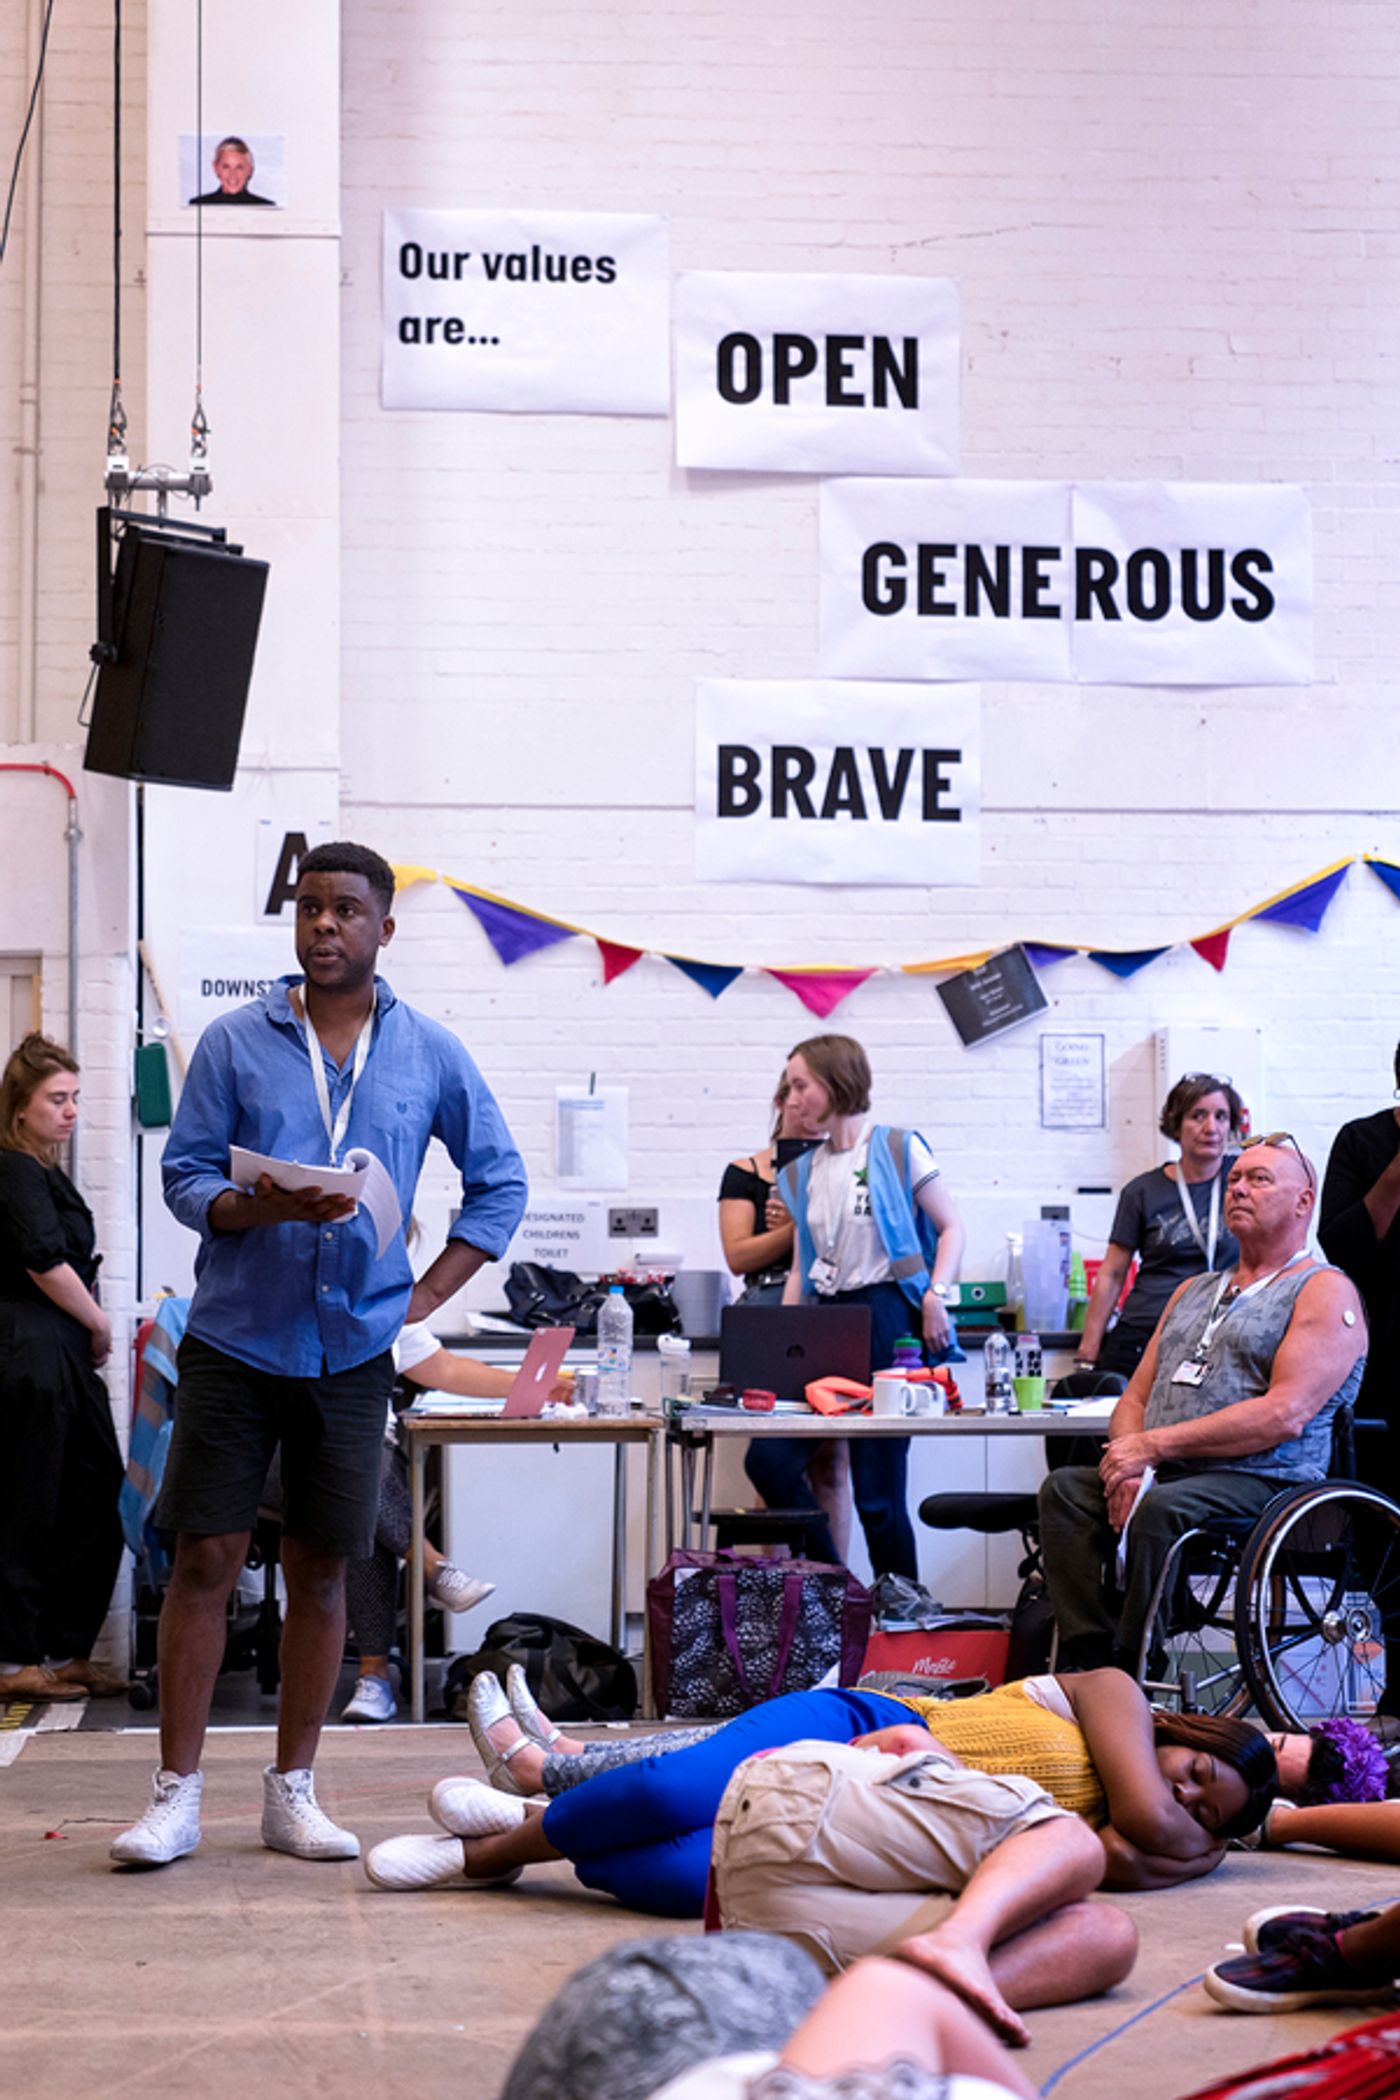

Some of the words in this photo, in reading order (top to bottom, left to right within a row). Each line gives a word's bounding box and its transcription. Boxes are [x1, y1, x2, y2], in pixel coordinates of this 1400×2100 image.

[399, 242, 471, 281] Our
[482, 244, 617, 284] values
[398, 316, 500, 346] are...
[716, 331, 919, 409] OPEN
[861, 541, 1275, 623] GENEROUS
[717, 744, 962, 822] BRAVE
[522, 1229, 580, 1240] CHILDRENS
[523, 1213, 585, 1223] ESIGNATED
